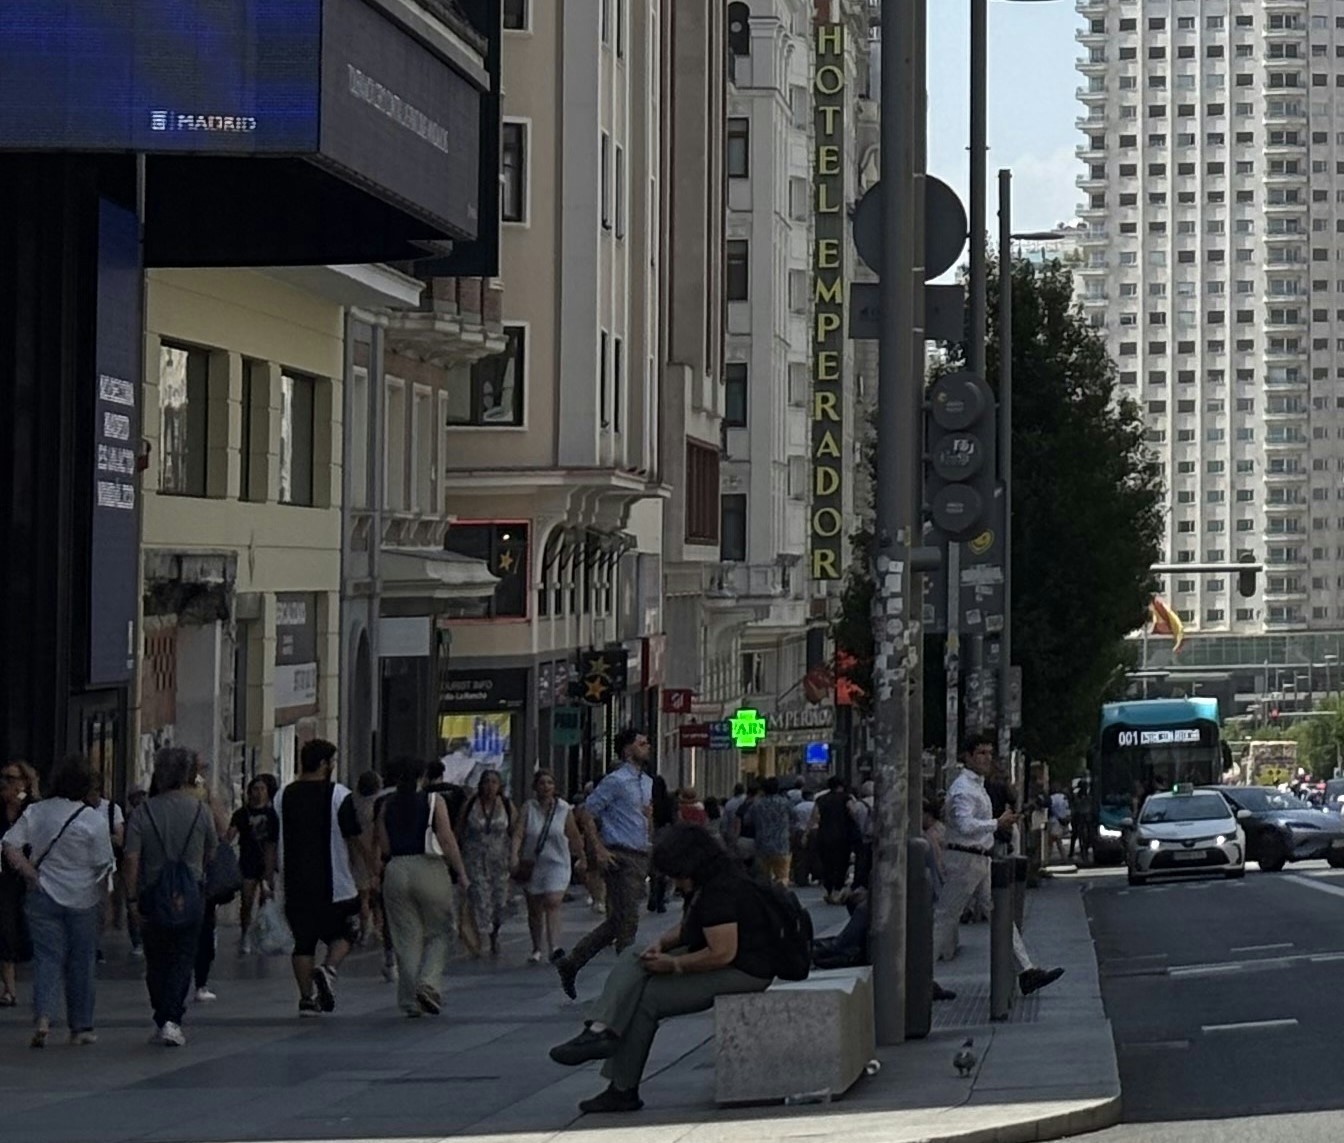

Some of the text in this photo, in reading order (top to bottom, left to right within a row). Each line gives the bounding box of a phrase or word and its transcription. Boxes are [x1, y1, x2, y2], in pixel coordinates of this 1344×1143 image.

[177, 114, 257, 131] MADRID
[811, 24, 844, 578] HOTEL EMPERADOR
[1118, 730, 1138, 747] 001
